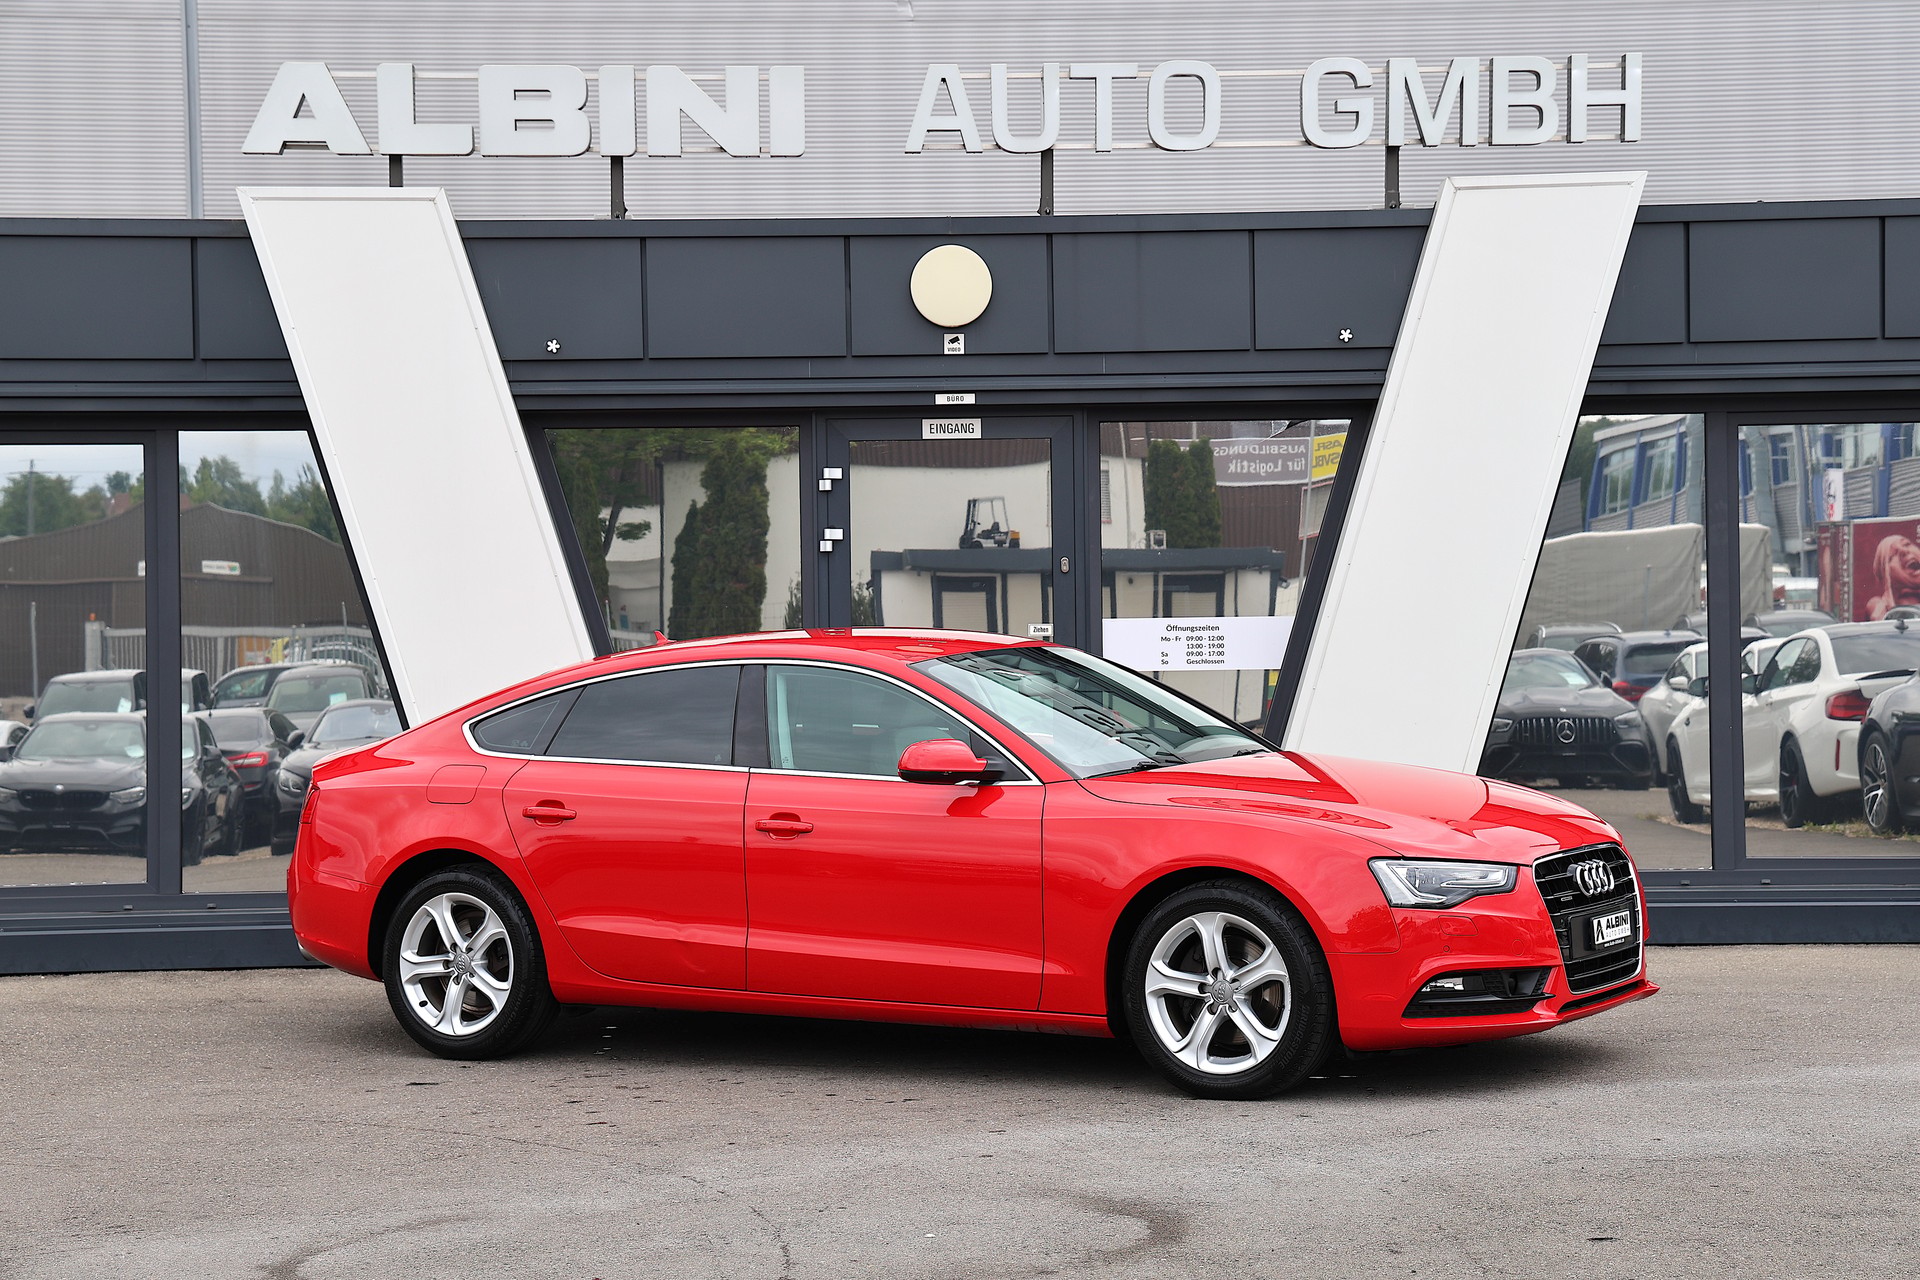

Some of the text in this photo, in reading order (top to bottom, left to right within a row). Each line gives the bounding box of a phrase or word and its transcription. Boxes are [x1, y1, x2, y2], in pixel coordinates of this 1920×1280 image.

[241, 52, 1644, 158] ALBINI AUTO GMBH
[946, 394, 965, 402] BÜRO
[929, 423, 975, 434] EINGANG
[1165, 624, 1220, 633] Öffnungszeiten
[1605, 913, 1629, 931] ALBINI
